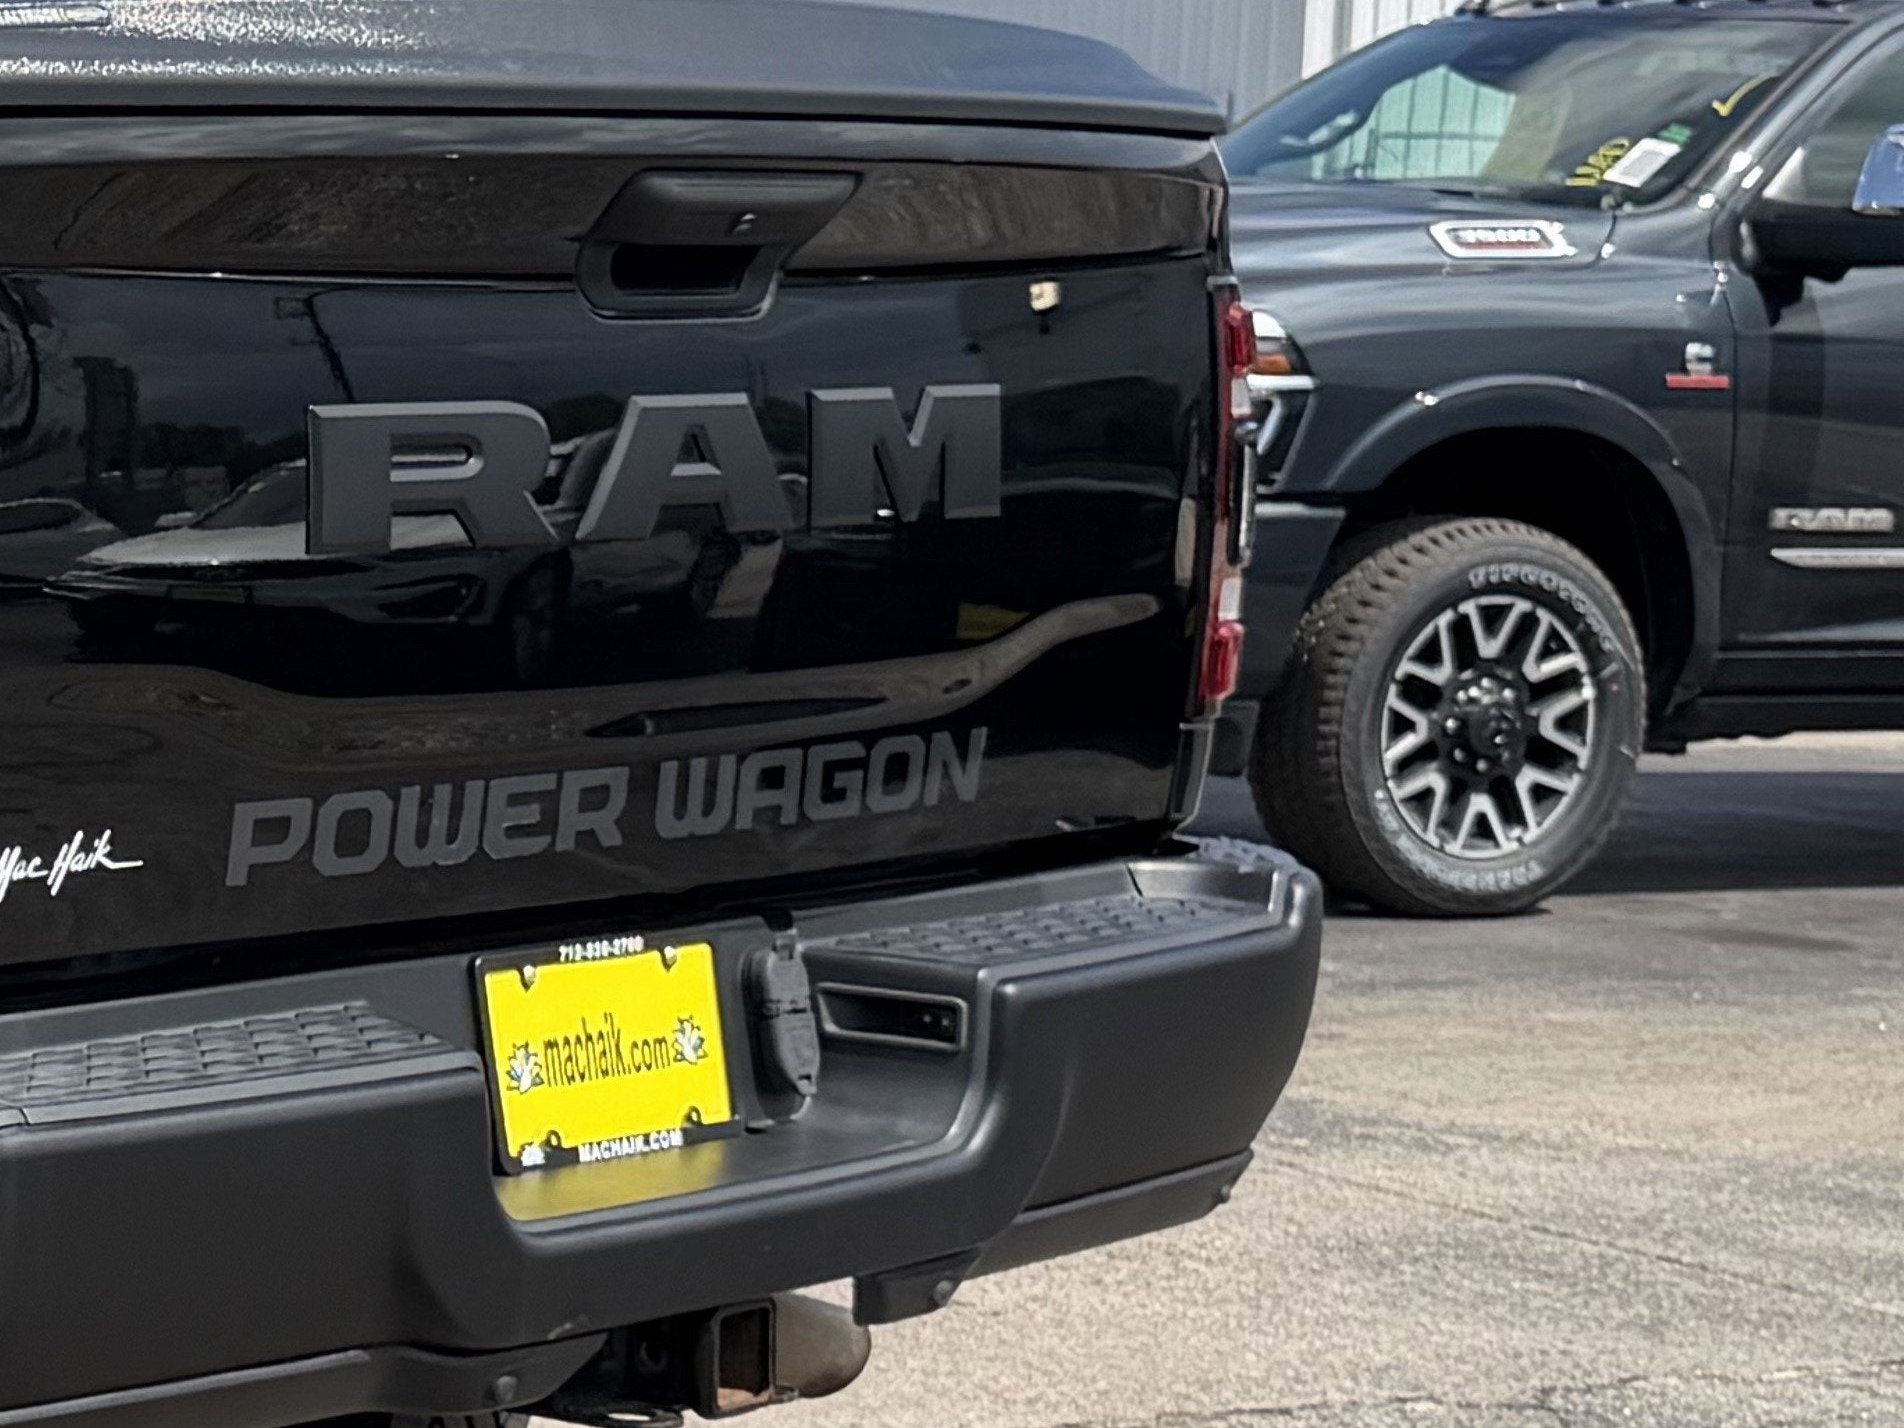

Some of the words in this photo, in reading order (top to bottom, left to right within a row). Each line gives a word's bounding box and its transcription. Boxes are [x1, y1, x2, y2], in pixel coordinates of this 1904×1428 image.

[305, 383, 1002, 555] RAM
[224, 766, 631, 887] POWER
[654, 726, 988, 839] WAGON
[46, 828, 144, 897] Haik
[542, 1011, 671, 1088] machaik.com
[578, 1127, 684, 1164] MACHAIK.COM
